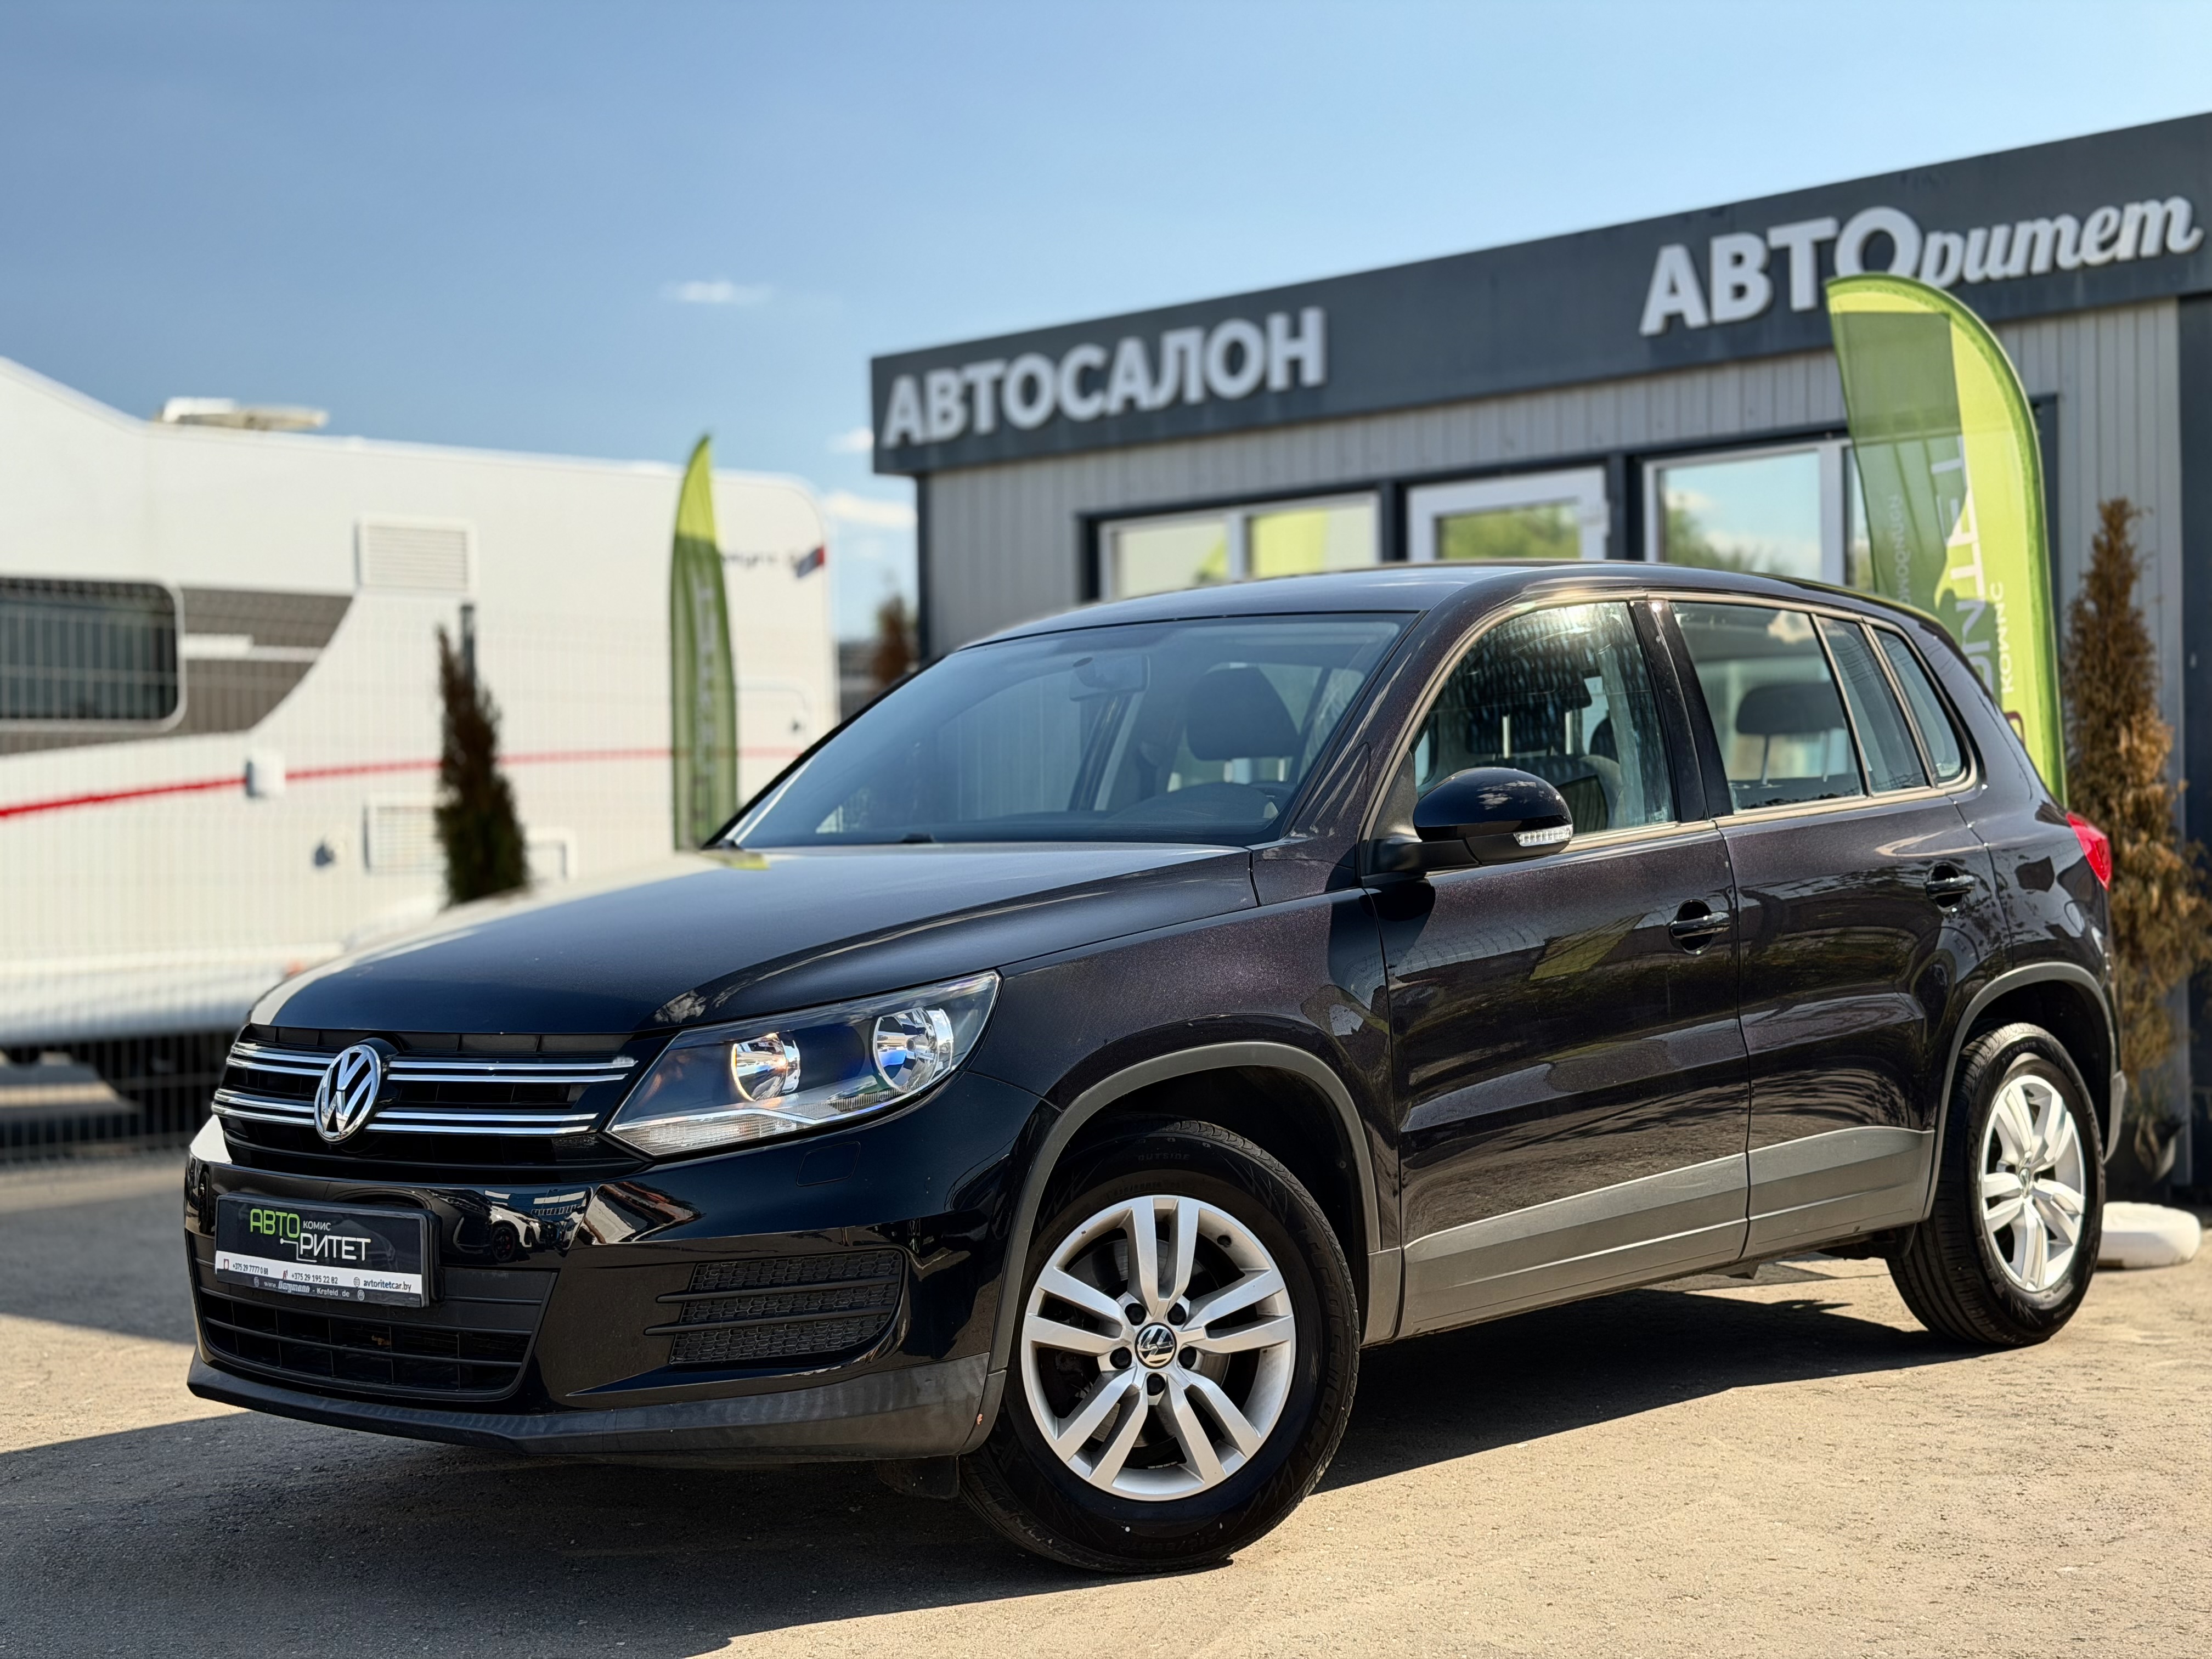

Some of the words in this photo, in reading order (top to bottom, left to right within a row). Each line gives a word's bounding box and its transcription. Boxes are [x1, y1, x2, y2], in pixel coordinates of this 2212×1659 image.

[882, 306, 1327, 450] АВТОСАЛОН
[250, 1208, 300, 1238] АВТО
[303, 1220, 331, 1231] КОМИС
[300, 1232, 371, 1261] РИТЕТ
[291, 1272, 303, 1280] +375
[363, 1279, 412, 1293] avtoritetcar.by
